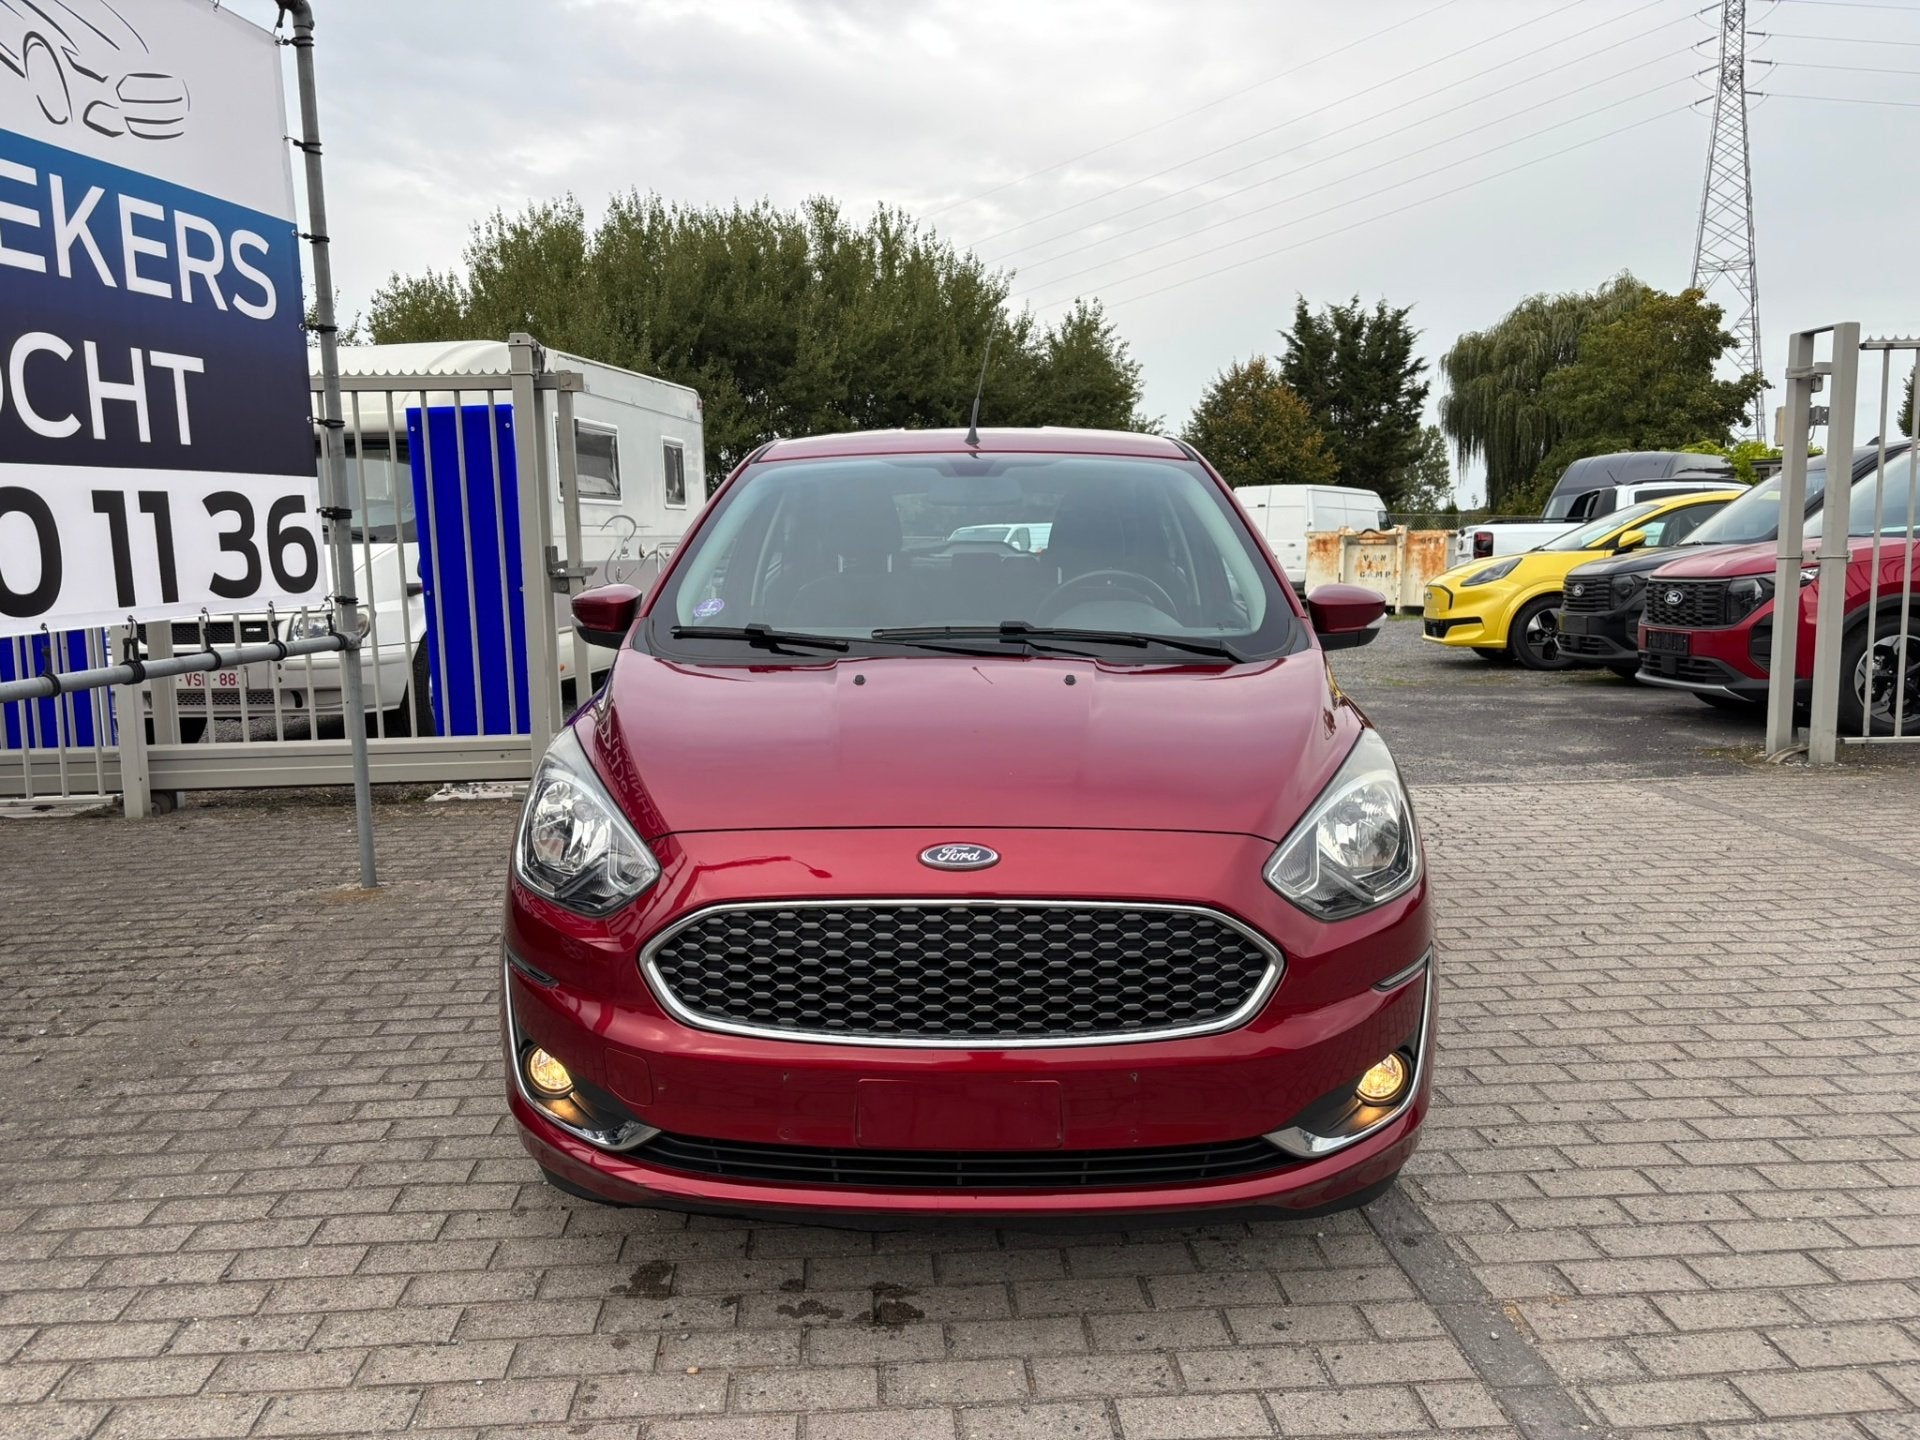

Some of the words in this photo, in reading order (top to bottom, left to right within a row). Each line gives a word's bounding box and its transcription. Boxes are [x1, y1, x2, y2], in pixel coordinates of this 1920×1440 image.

[0, 331, 205, 445] CHT
[91, 490, 179, 608] 11
[202, 490, 319, 599] 36
[937, 846, 981, 861] Ford
